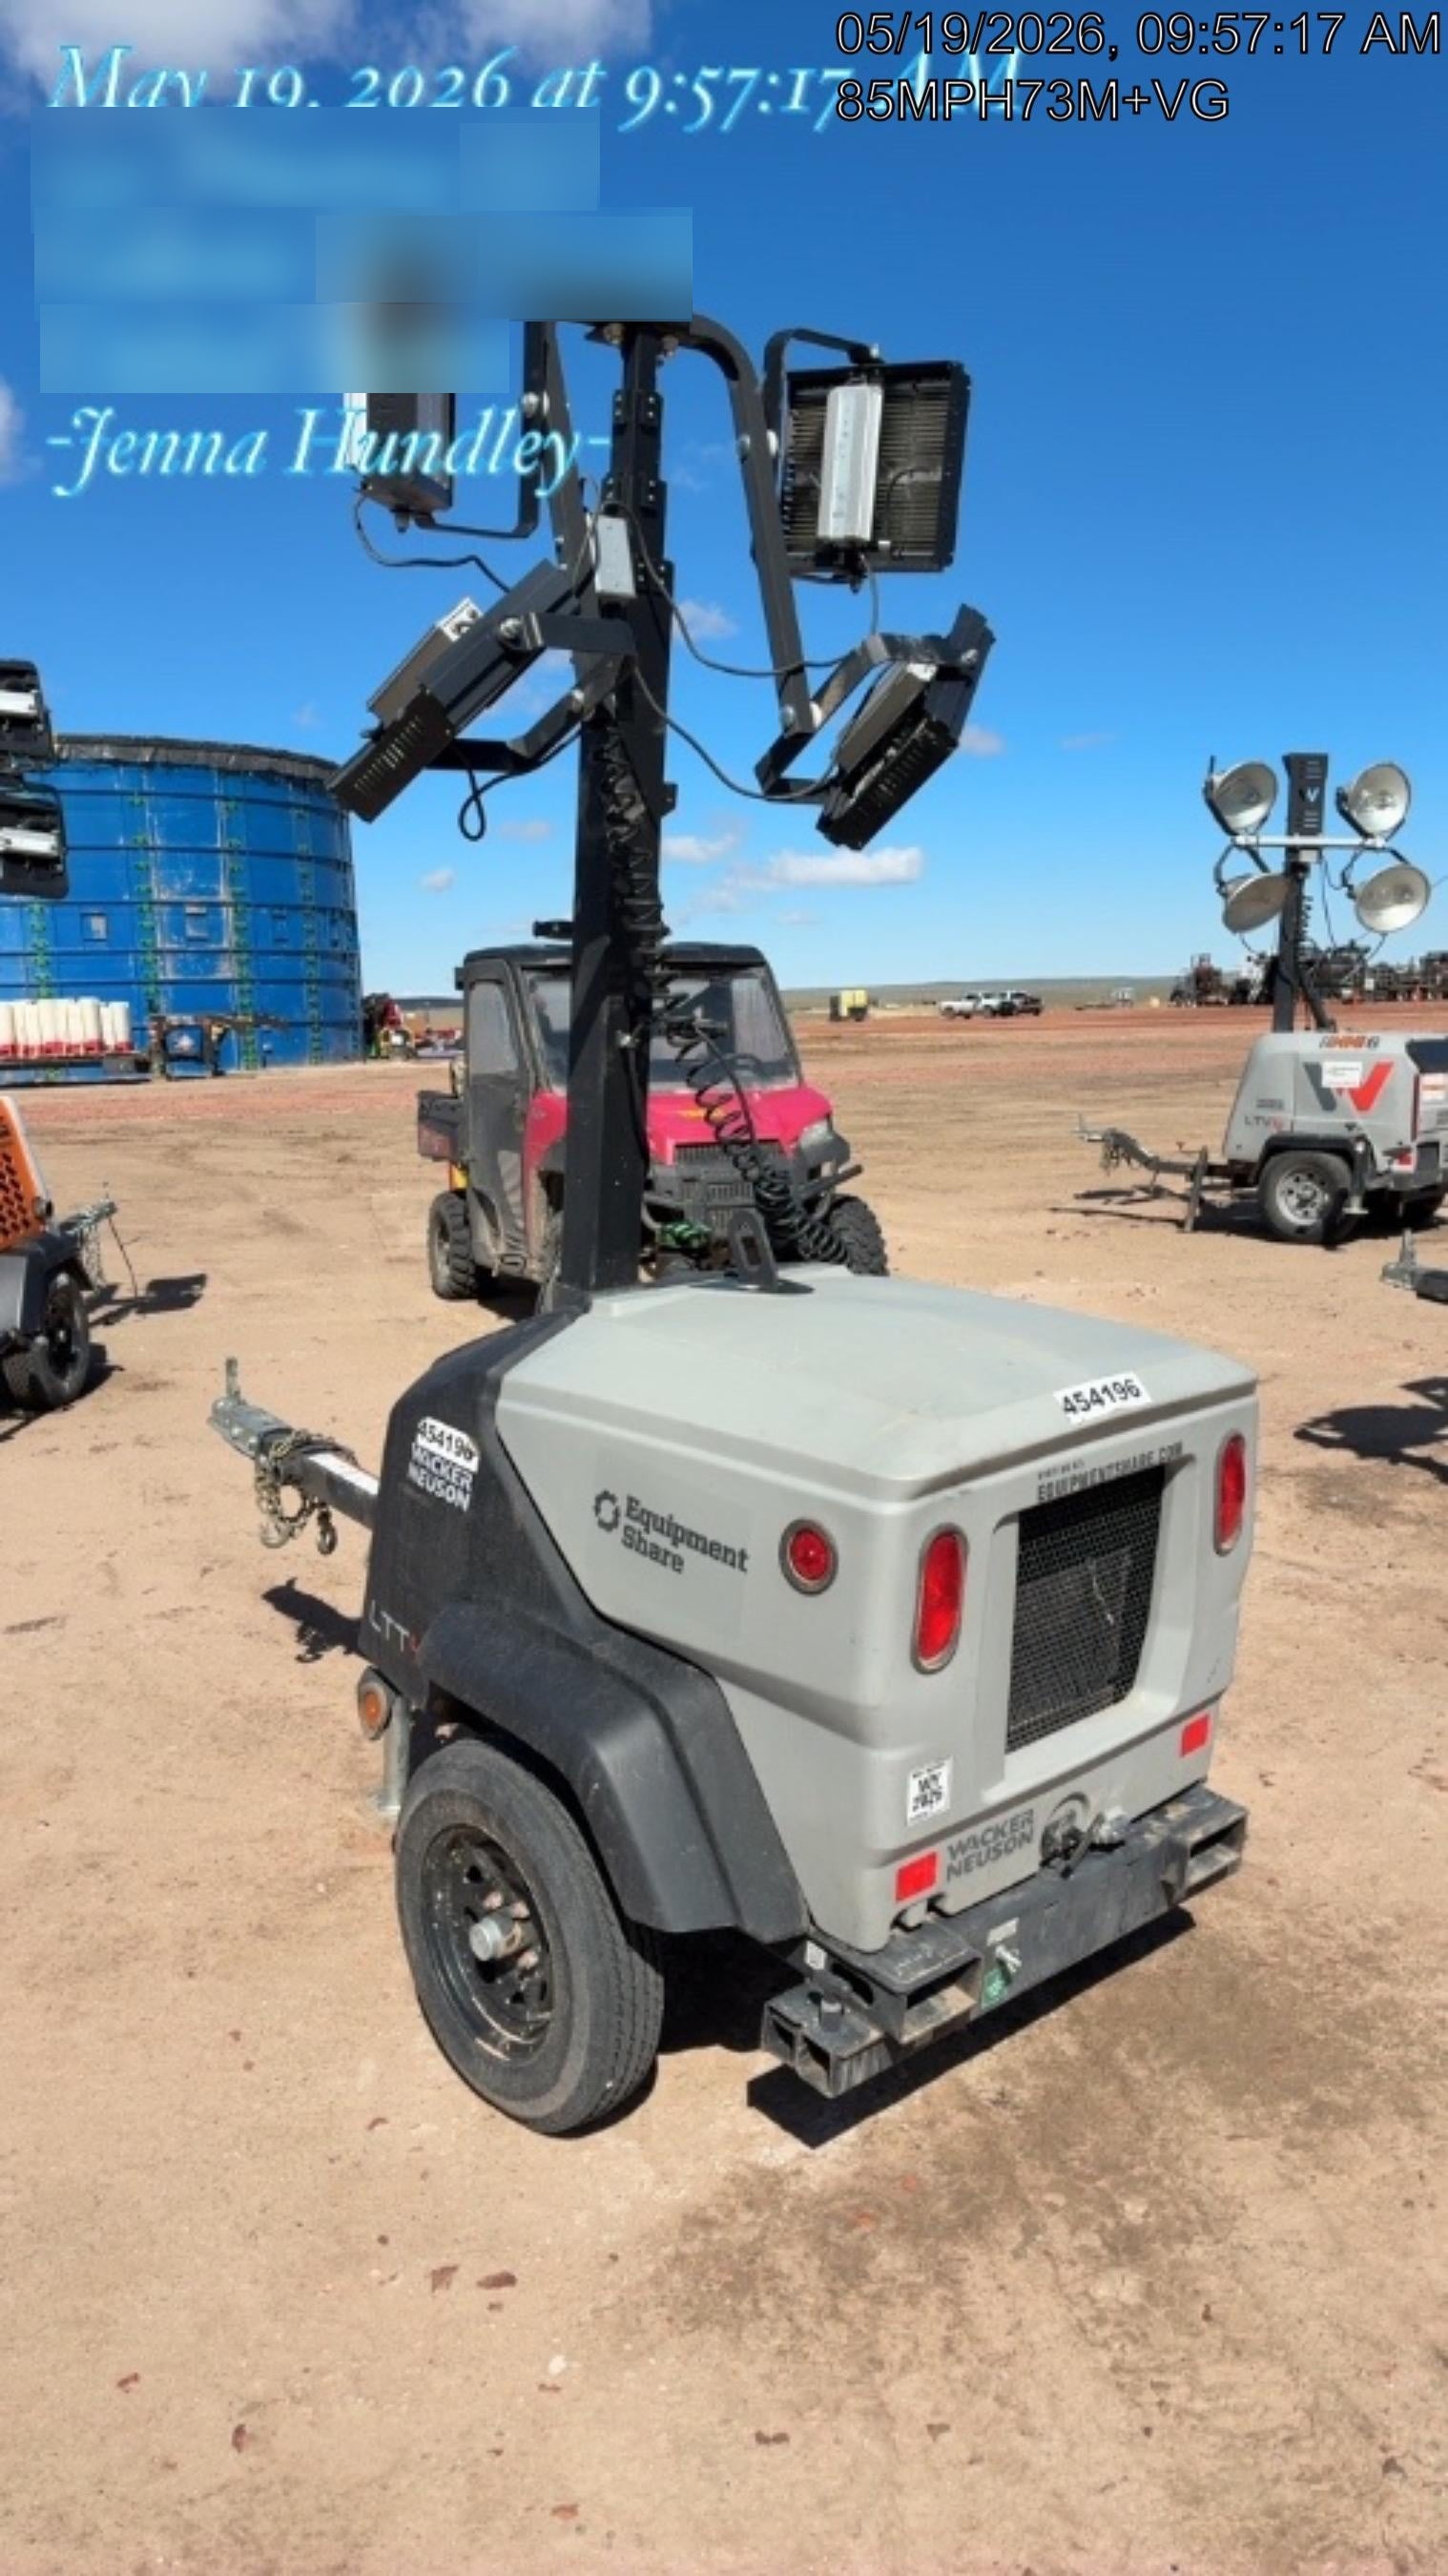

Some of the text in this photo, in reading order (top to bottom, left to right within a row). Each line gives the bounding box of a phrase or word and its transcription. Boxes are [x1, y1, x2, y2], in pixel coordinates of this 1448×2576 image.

[1063, 1379, 1141, 1415] 454196
[407, 1462, 470, 1512] NEUSON
[410, 1442, 474, 1494] WACKER
[621, 1524, 685, 1574] Share
[626, 1493, 750, 1573] Equipment
[946, 1809, 1034, 1860] WACKER
[946, 1831, 1033, 1881] NEUSON
